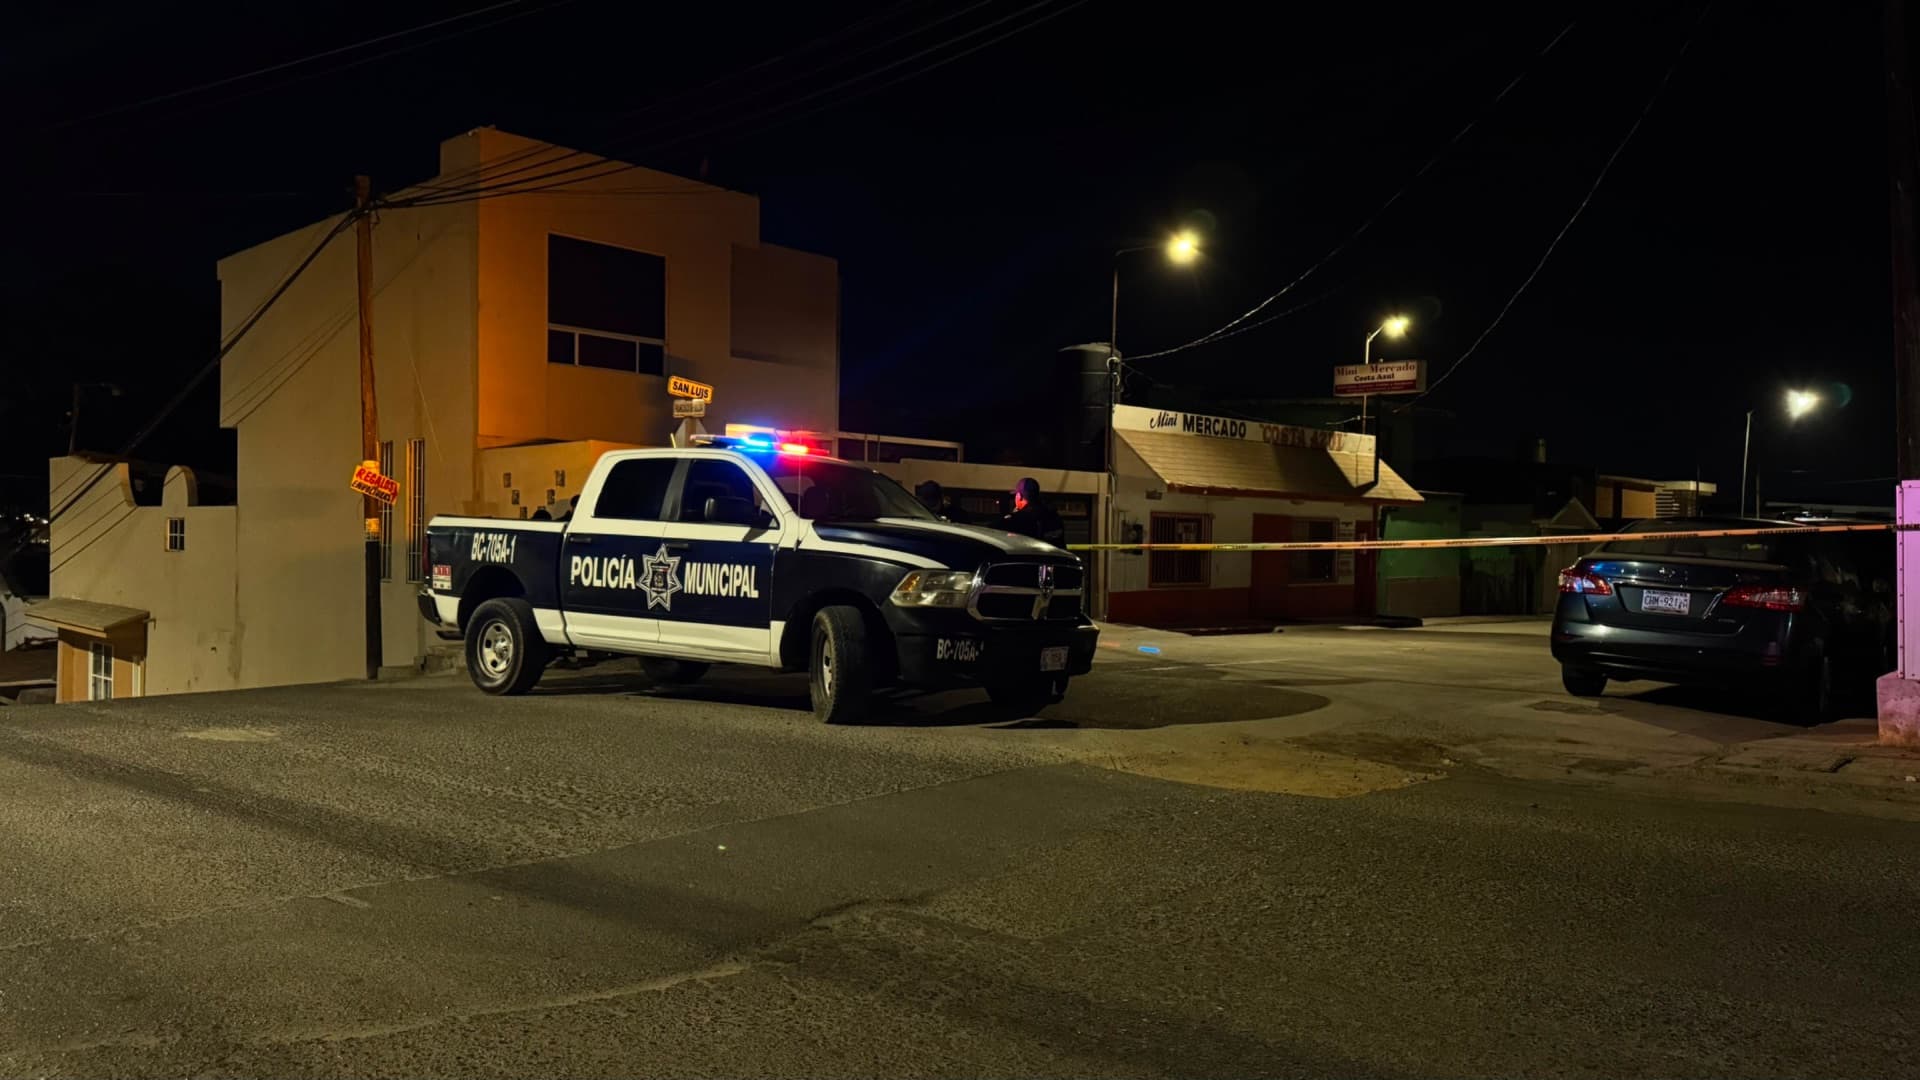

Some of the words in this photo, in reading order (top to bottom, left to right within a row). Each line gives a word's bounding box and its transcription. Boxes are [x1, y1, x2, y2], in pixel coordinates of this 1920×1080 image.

[1370, 363, 1415, 373] Mercado
[673, 381, 690, 393] SAN
[691, 386, 709, 399] LUIS
[1150, 411, 1178, 429] Mini
[1182, 414, 1247, 439] MERCADO
[471, 532, 517, 564] BC-705A-1
[570, 554, 636, 590] POLICÍA
[684, 562, 760, 598] MUNICIPAL
